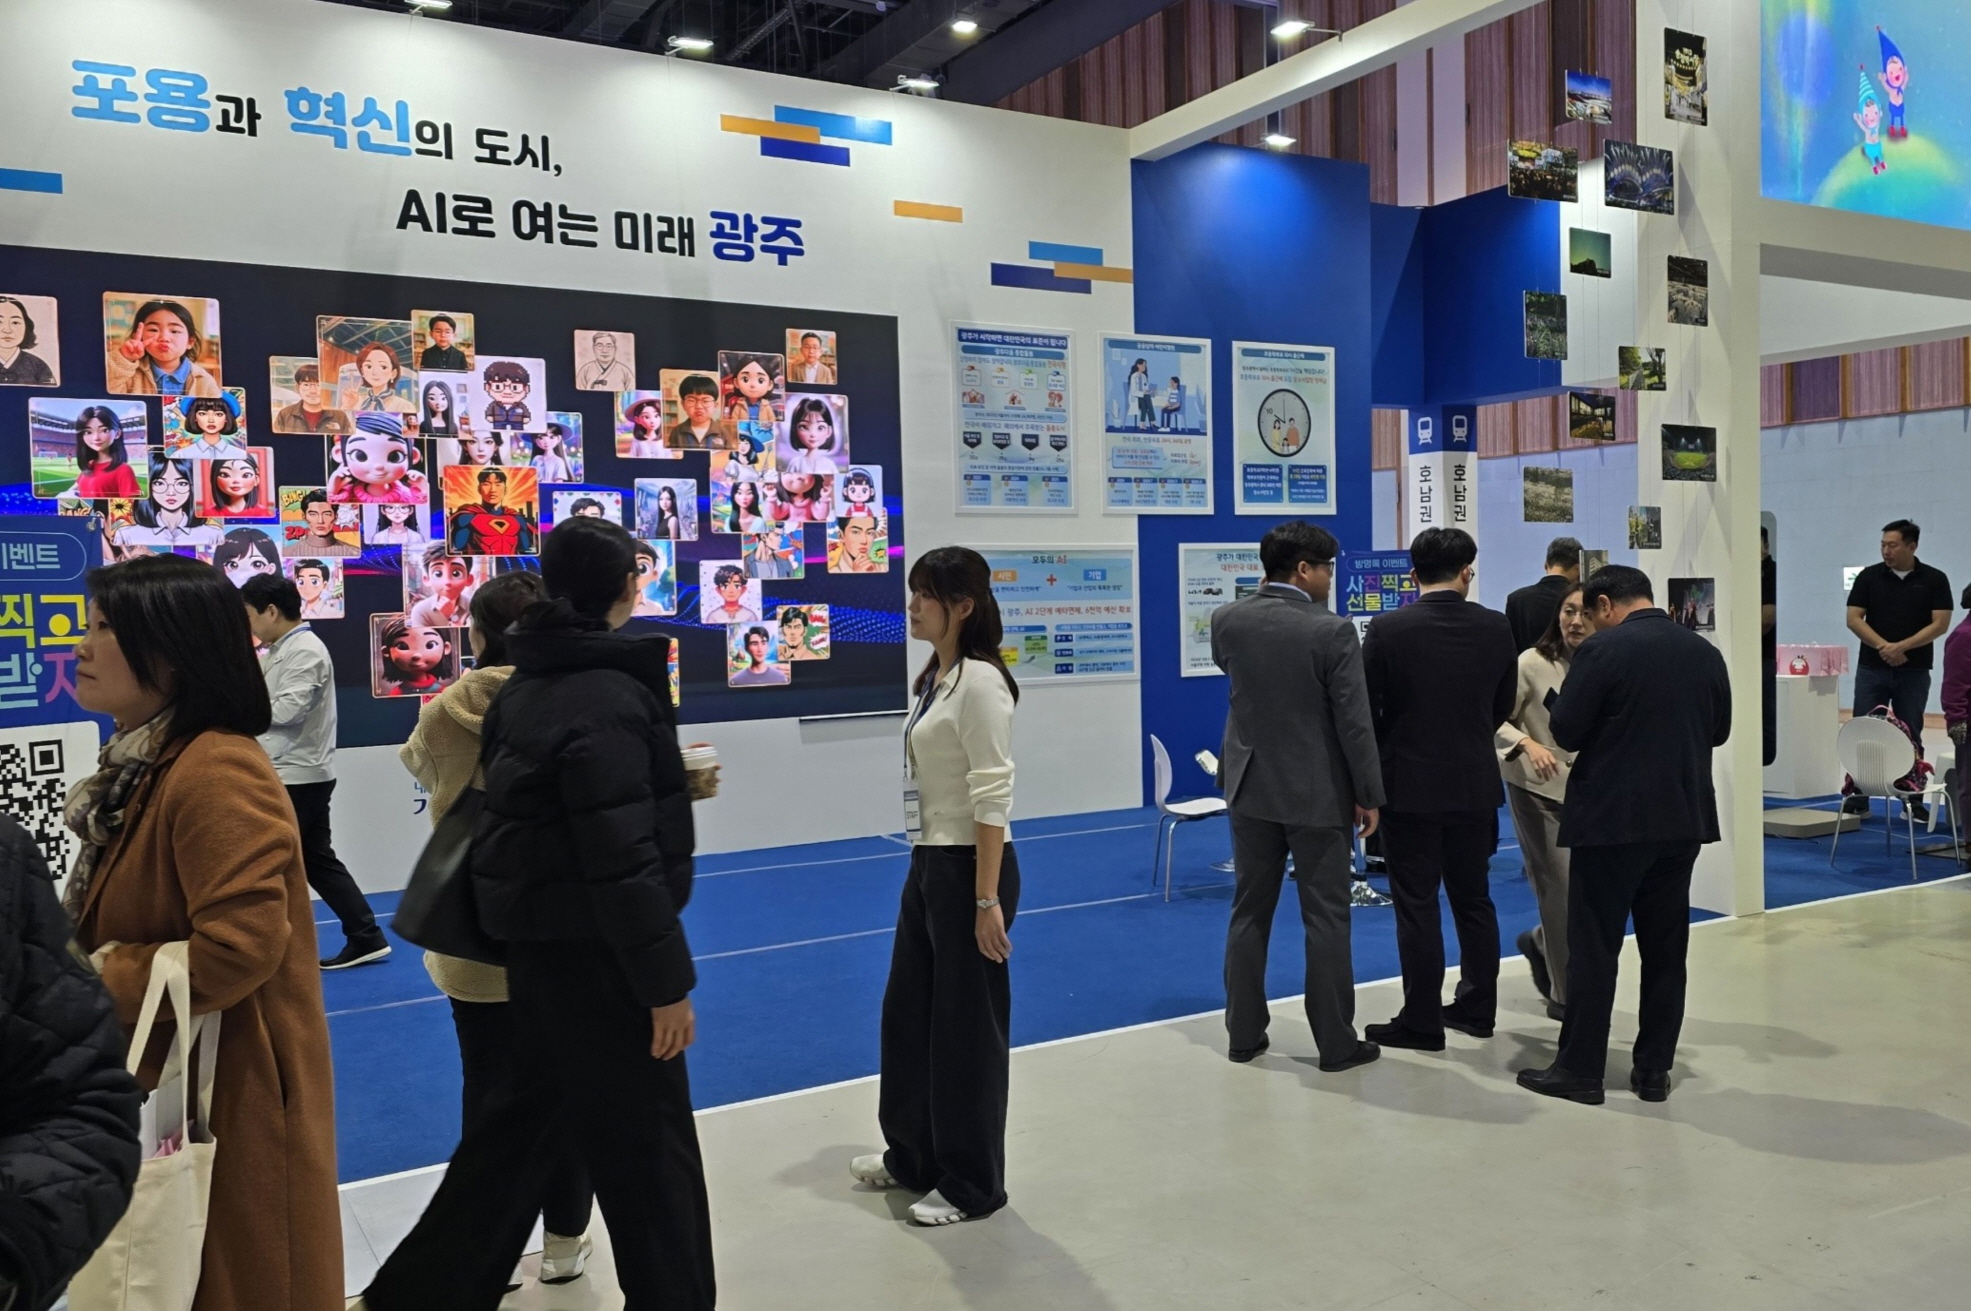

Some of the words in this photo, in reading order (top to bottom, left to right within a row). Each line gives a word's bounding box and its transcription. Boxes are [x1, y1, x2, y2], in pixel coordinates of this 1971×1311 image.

[71, 58, 262, 138] 포용과
[284, 86, 454, 160] 혁신의
[474, 130, 563, 177] 도시,
[396, 187, 496, 239] AI로
[512, 199, 600, 248] 여는
[615, 210, 696, 260] 미래
[708, 210, 806, 267] 광주
[961, 332, 978, 340] 광주가
[1420, 465, 1432, 523] 호남권
[1454, 464, 1466, 522] 호남권
[1032, 556, 1054, 564] 모두의
[1056, 555, 1067, 564] AI
[1382, 558, 1408, 568] 이벤트
[1088, 571, 1102, 580] 기업
[1035, 607, 1053, 615] 2단계
